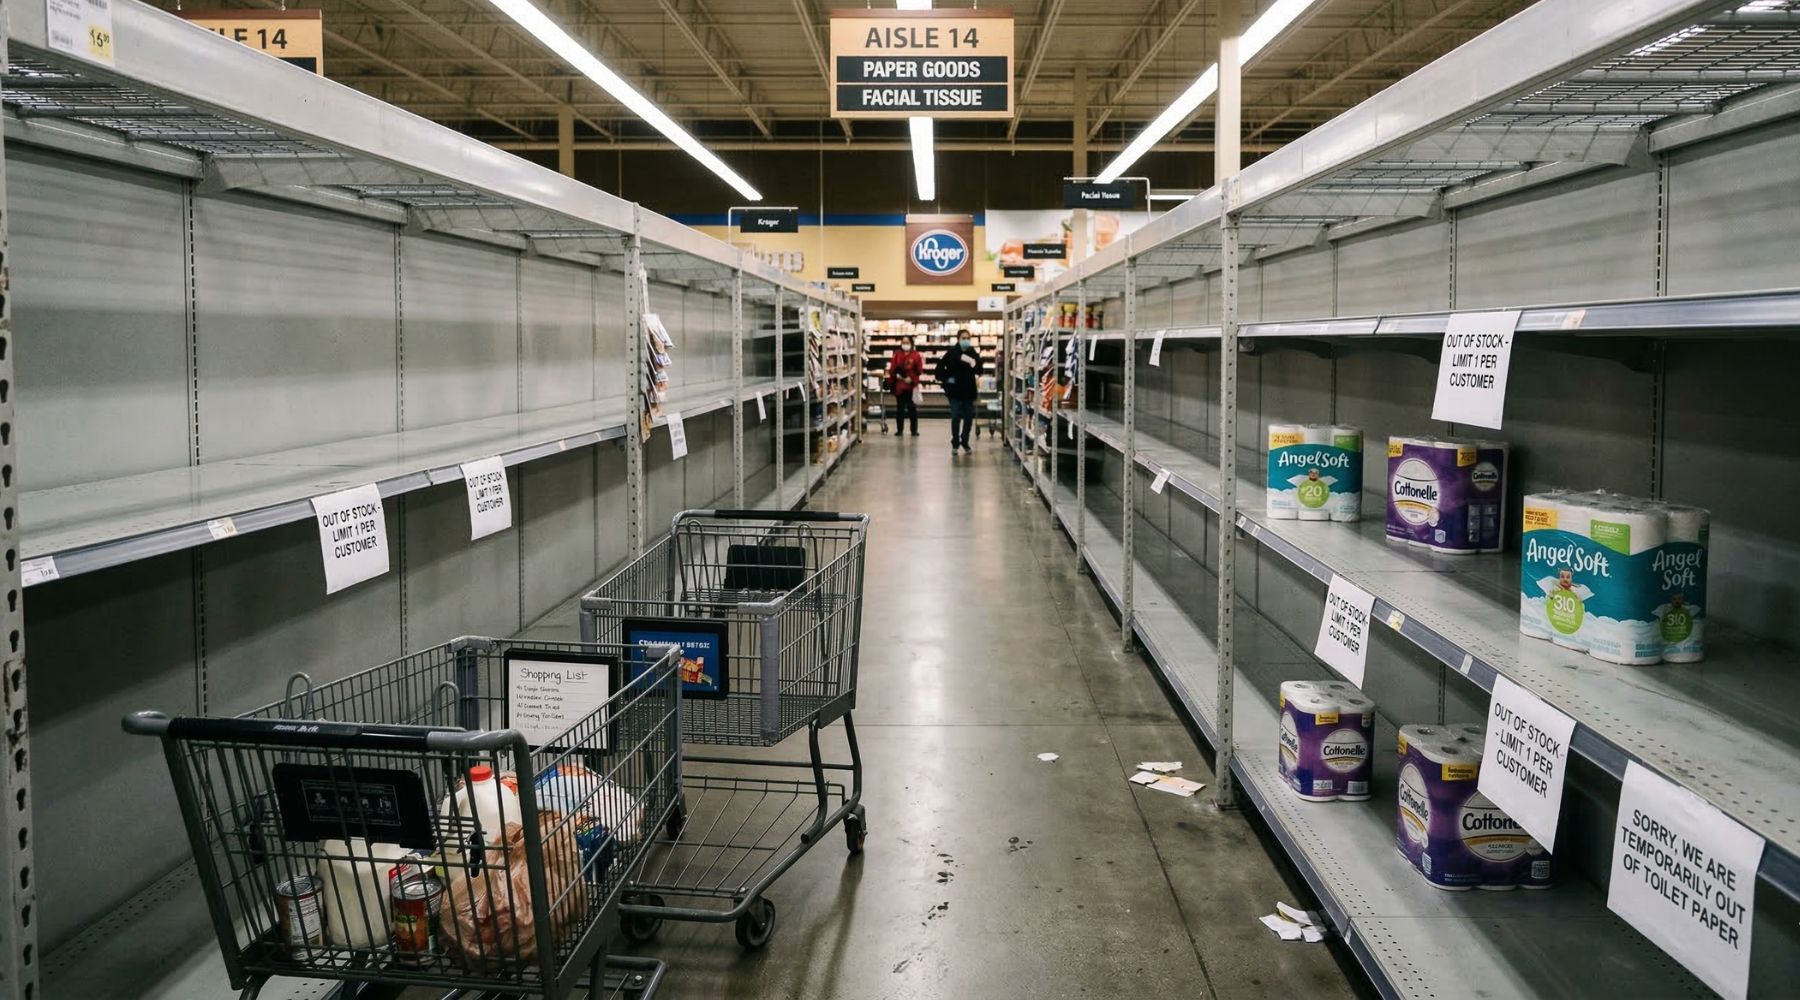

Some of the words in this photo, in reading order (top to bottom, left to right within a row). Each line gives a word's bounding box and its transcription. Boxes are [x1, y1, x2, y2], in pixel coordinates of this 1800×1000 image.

[257, 28, 287, 49] 14
[865, 27, 939, 48] AISLE
[948, 27, 980, 48] 14
[863, 61, 917, 78] PAPER
[922, 61, 981, 78] GOODS
[862, 89, 920, 106] FACIAL
[923, 89, 982, 106] TISSUE
[918, 237, 963, 269] Kroger
[1446, 334, 1463, 348] OUT
[1464, 334, 1475, 348] OF
[1476, 334, 1504, 348] STOCK
[1452, 354, 1474, 367] LIMIT
[1475, 355, 1479, 368] 1
[1480, 355, 1498, 369] PER
[1449, 372, 1494, 389] CUSTOMER
[1278, 450, 1321, 468] Angel
[1321, 452, 1350, 468] Soft
[1394, 480, 1438, 501] Cottonelle
[322, 512, 339, 528] OUT
[340, 508, 351, 523] OF
[351, 503, 377, 520] STOCK
[332, 525, 353, 542] LIMIT
[355, 525, 360, 535] 1
[360, 519, 376, 534] PER
[334, 536, 378, 559] CUSTOMER
[1527, 538, 1573, 567] Angel
[1574, 547, 1610, 578] Soft
[1652, 549, 1703, 572] Angel
[1662, 567, 1696, 591] Soft
[1328, 593, 1340, 606] OUT
[1340, 599, 1349, 612] OF
[1331, 609, 1345, 628] LIMIT
[1349, 622, 1361, 639] PER
[1328, 625, 1360, 656] CUSTOMER
[520, 668, 562, 685] Shopping
[566, 669, 588, 680] List
[1494, 703, 1513, 725] OUT
[1513, 715, 1527, 733] OF
[1527, 724, 1561, 759] STOCK
[1323, 745, 1366, 756] Cottonelle
[1500, 728, 1525, 756] LIMIT
[1526, 747, 1531, 761] 1
[1533, 751, 1553, 779] PER
[1496, 749, 1547, 798] CUSTOMER
[1399, 783, 1429, 822] Cottonelle
[1462, 812, 1522, 831] Cotton
[1632, 808, 1678, 855] SORRY,
[1682, 839, 1703, 869] WE
[1706, 858, 1736, 891] ARE
[1621, 826, 1712, 900] TEMPORARILY
[1715, 891, 1746, 924] OUT
[1623, 853, 1641, 874] OF
[1643, 865, 1689, 910] TOILET
[1692, 900, 1739, 950] PAPER
